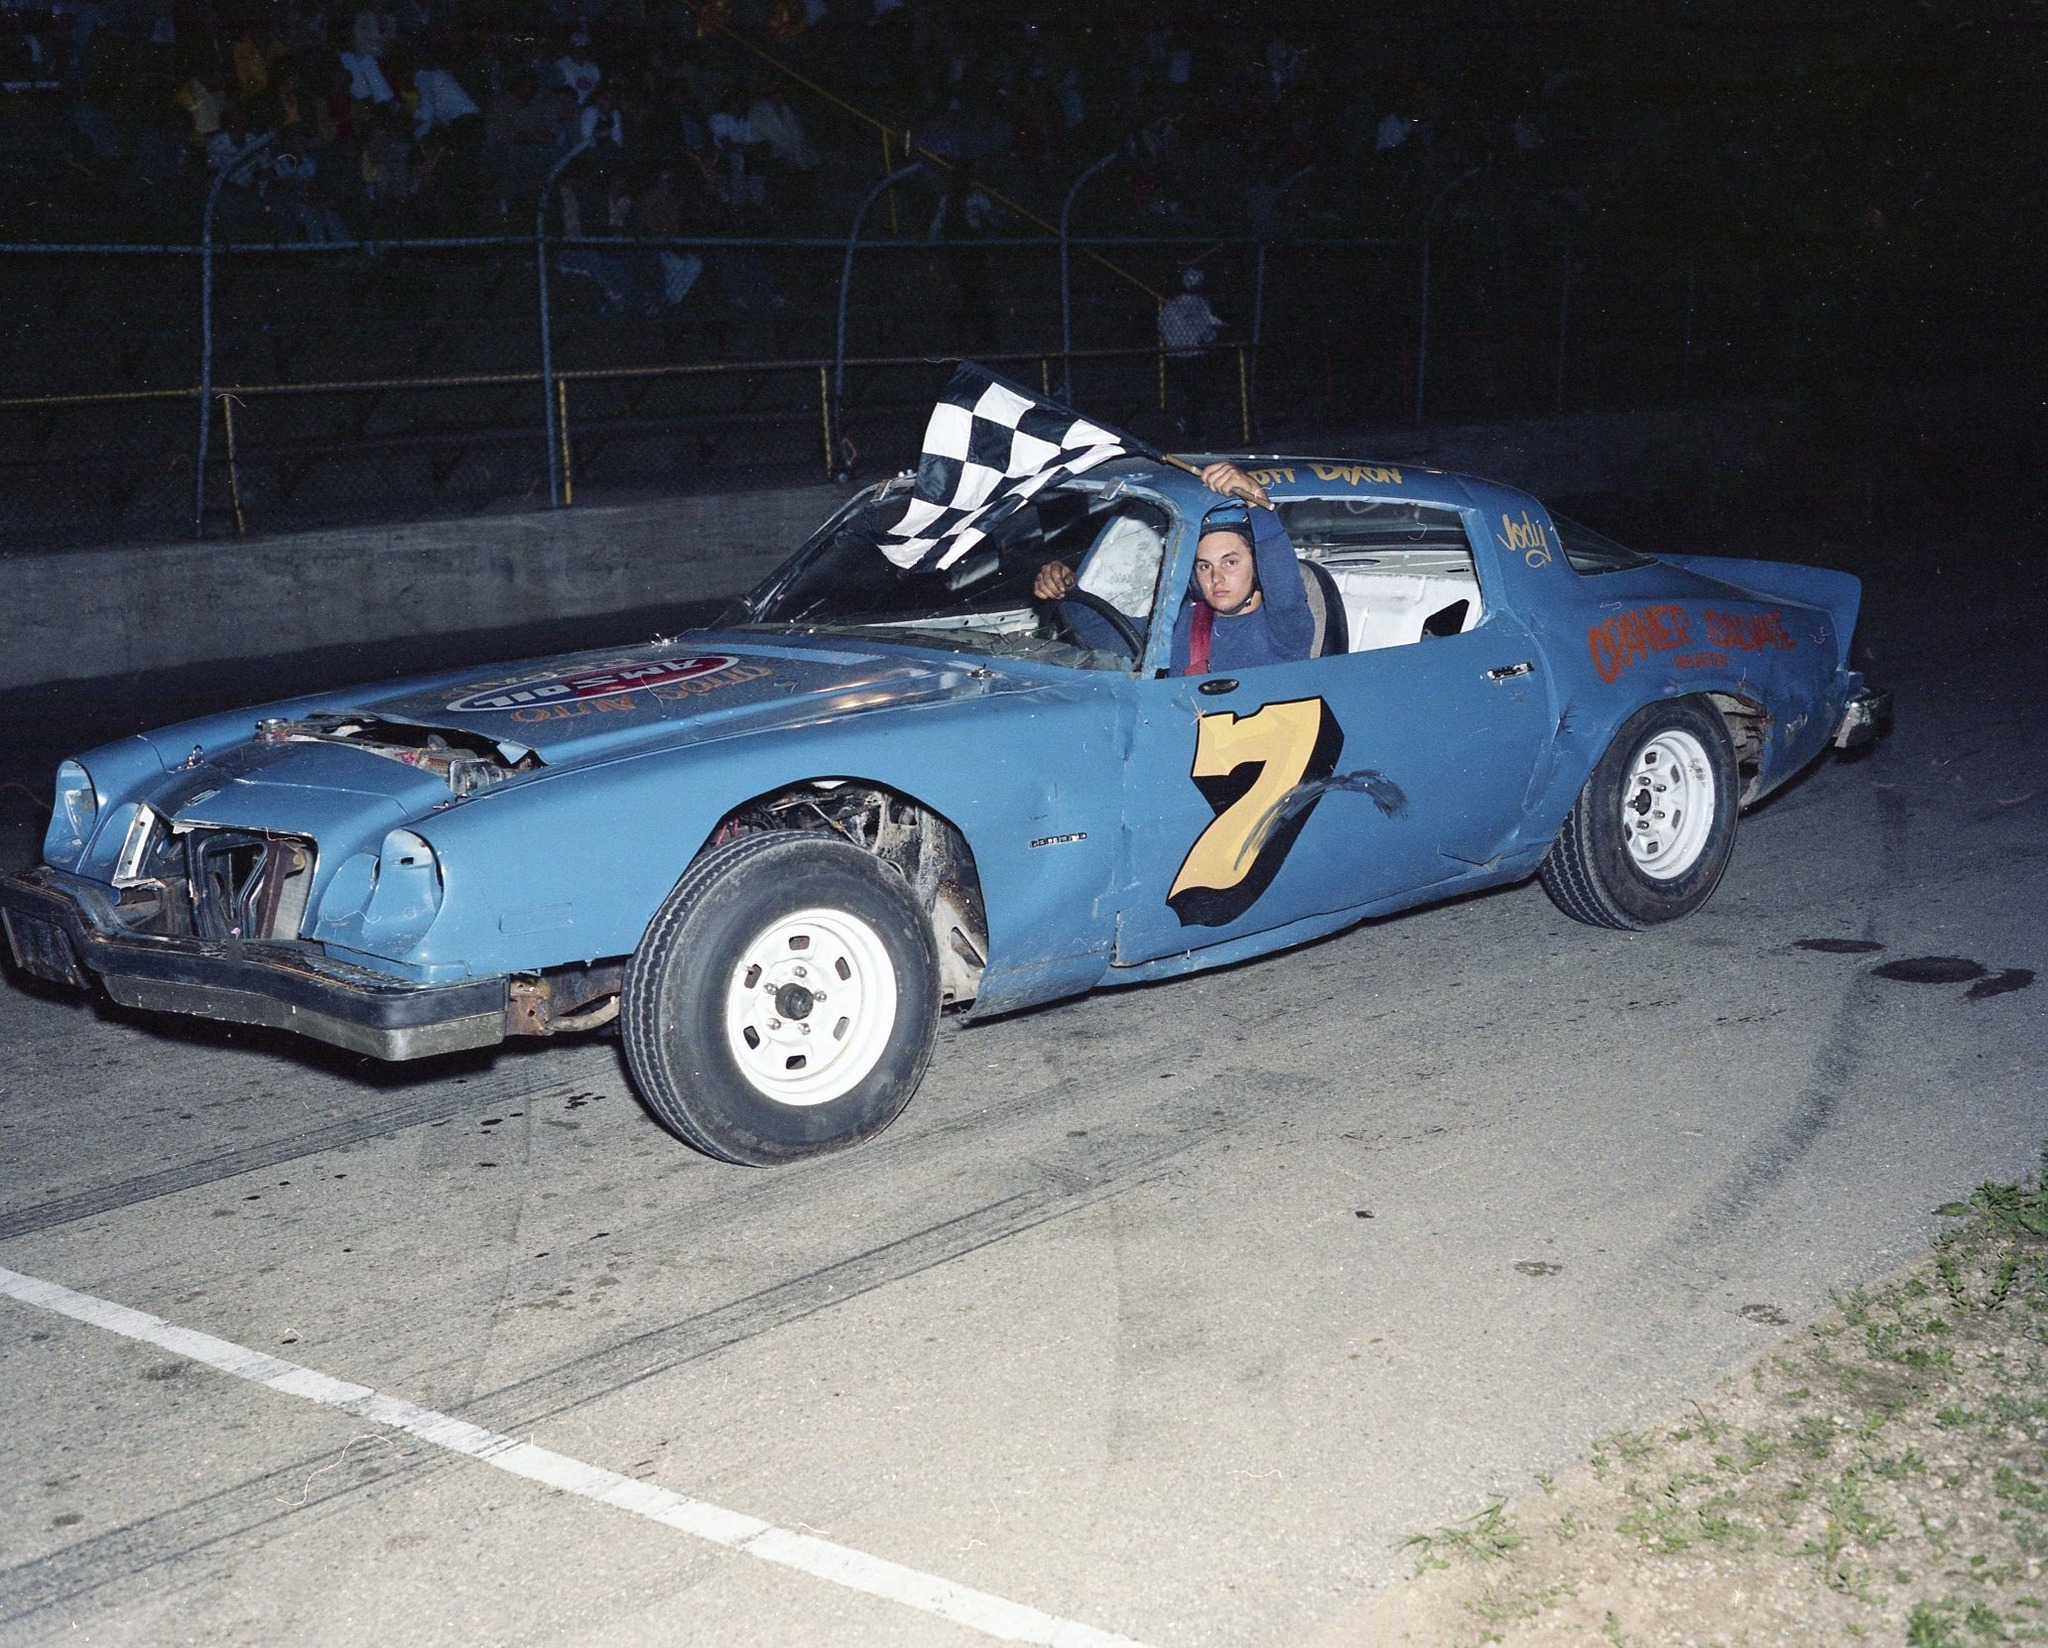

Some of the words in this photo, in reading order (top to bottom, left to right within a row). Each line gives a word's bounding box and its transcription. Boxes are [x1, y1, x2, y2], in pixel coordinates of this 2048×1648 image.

[1247, 467, 1296, 486] OTT
[1307, 463, 1403, 487] DIXON
[1497, 510, 1551, 568] Jody
[473, 658, 704, 708] AMSOIL
[510, 693, 636, 723] AUTO
[1165, 695, 1345, 928] 7
